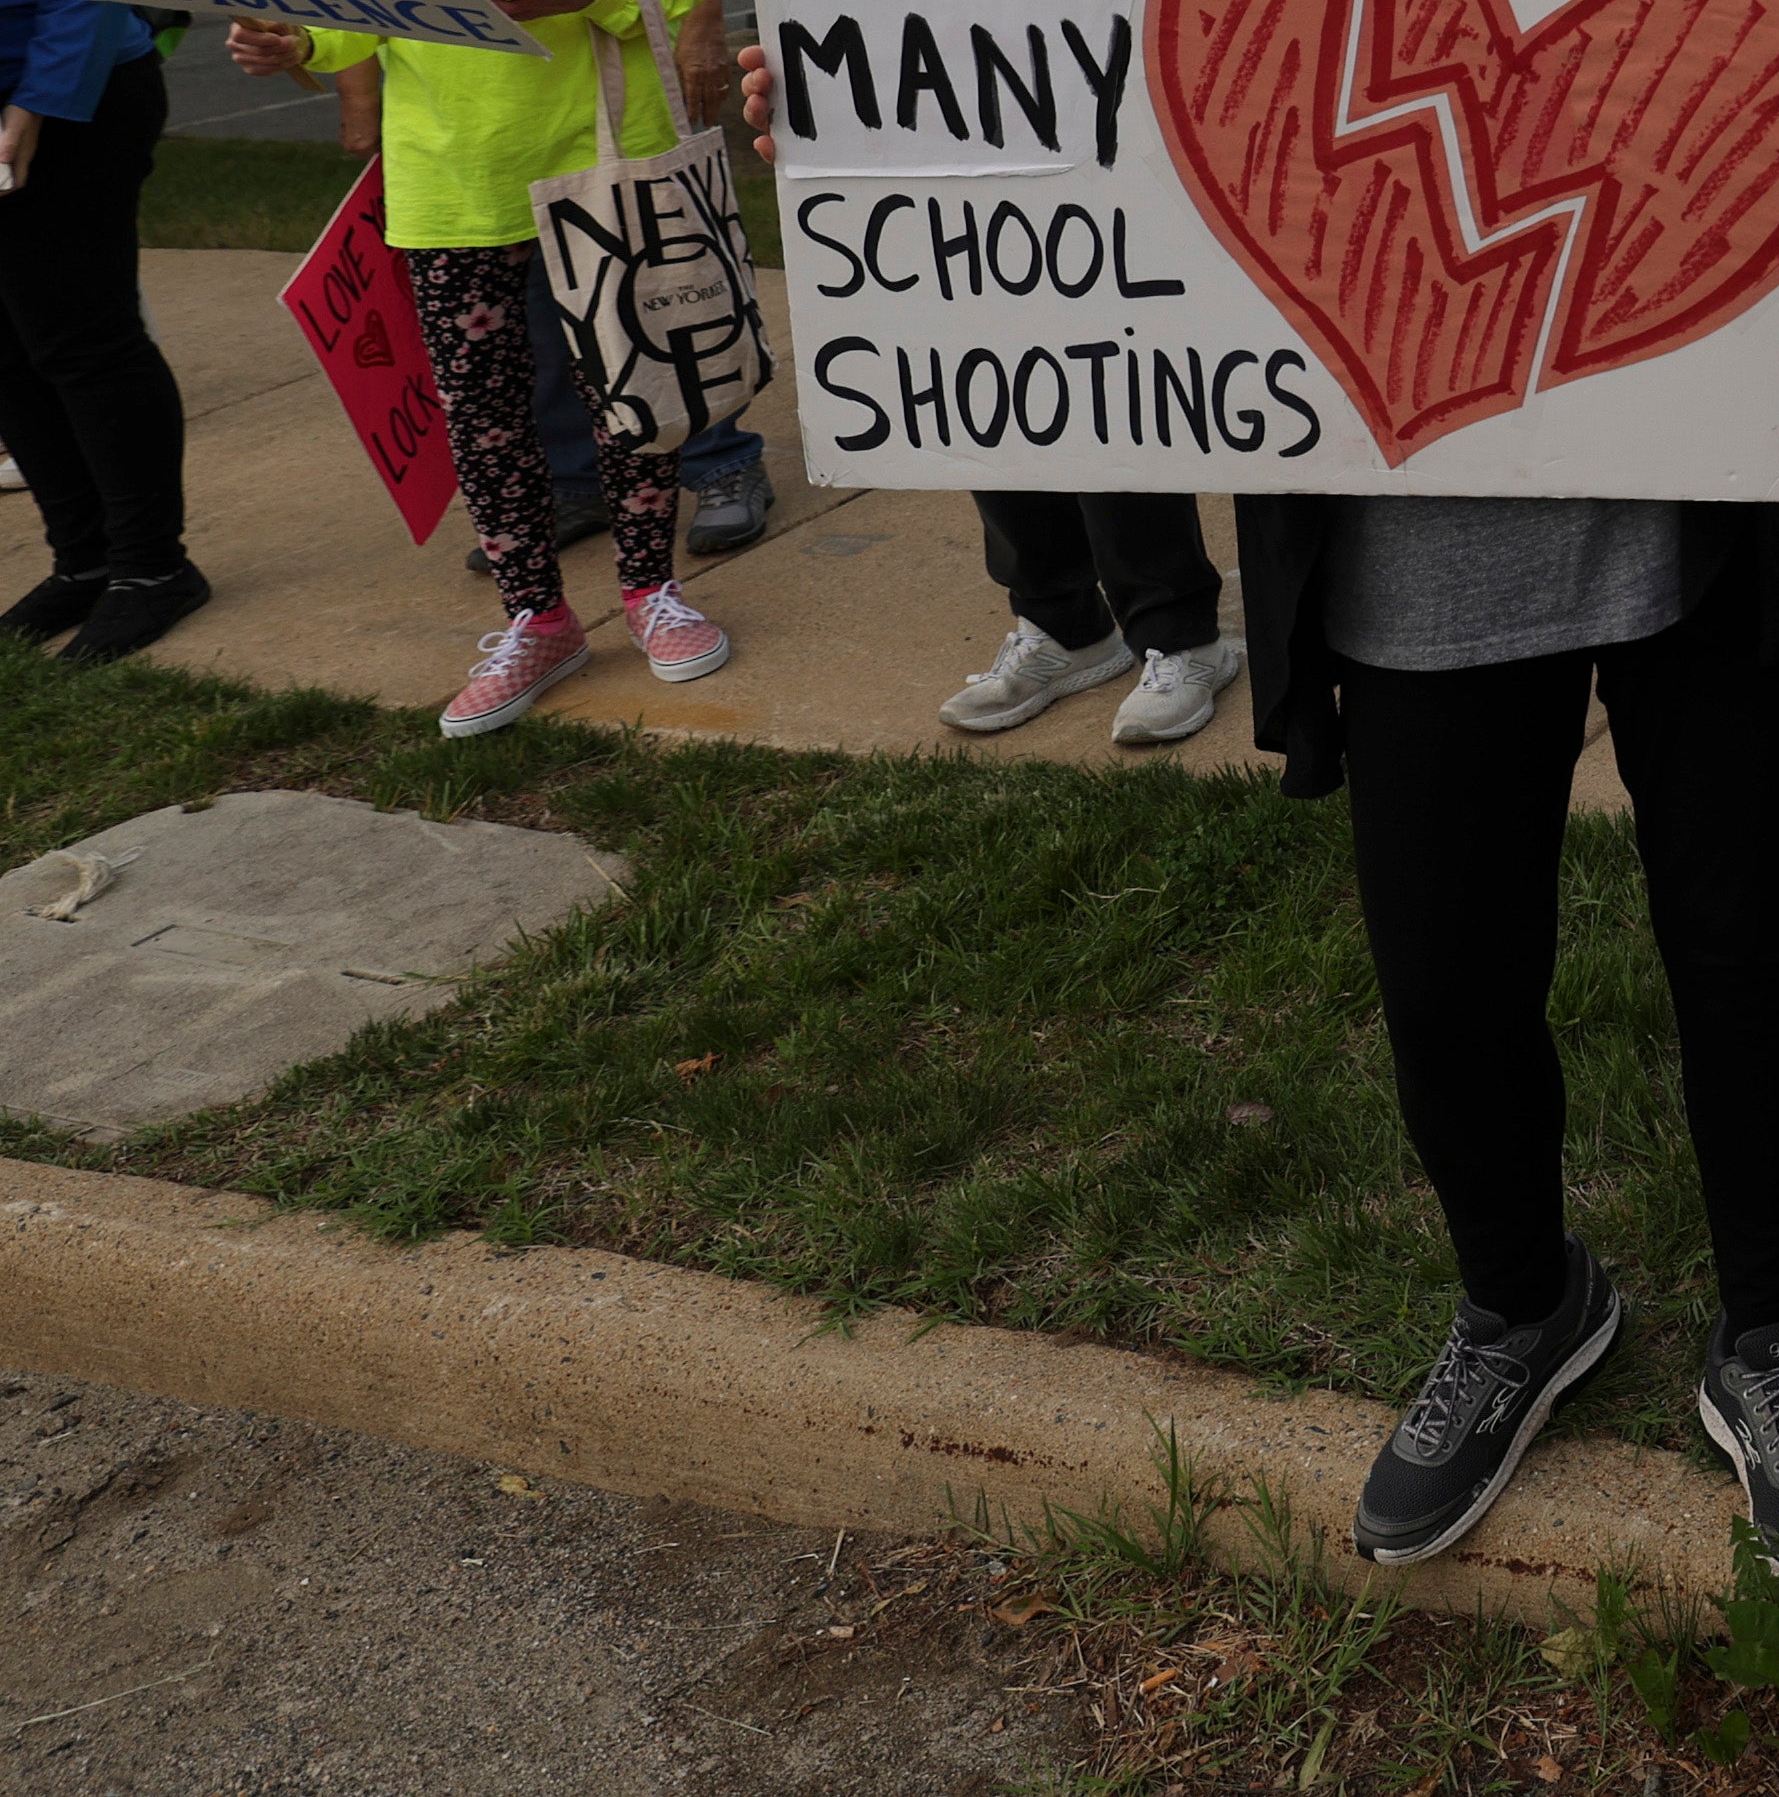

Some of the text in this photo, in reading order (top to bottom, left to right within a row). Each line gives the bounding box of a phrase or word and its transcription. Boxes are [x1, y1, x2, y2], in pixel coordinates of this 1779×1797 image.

[779, 11, 1132, 168] MANY
[298, 225, 374, 352] LOVE
[797, 192, 1186, 300] SCHOOL
